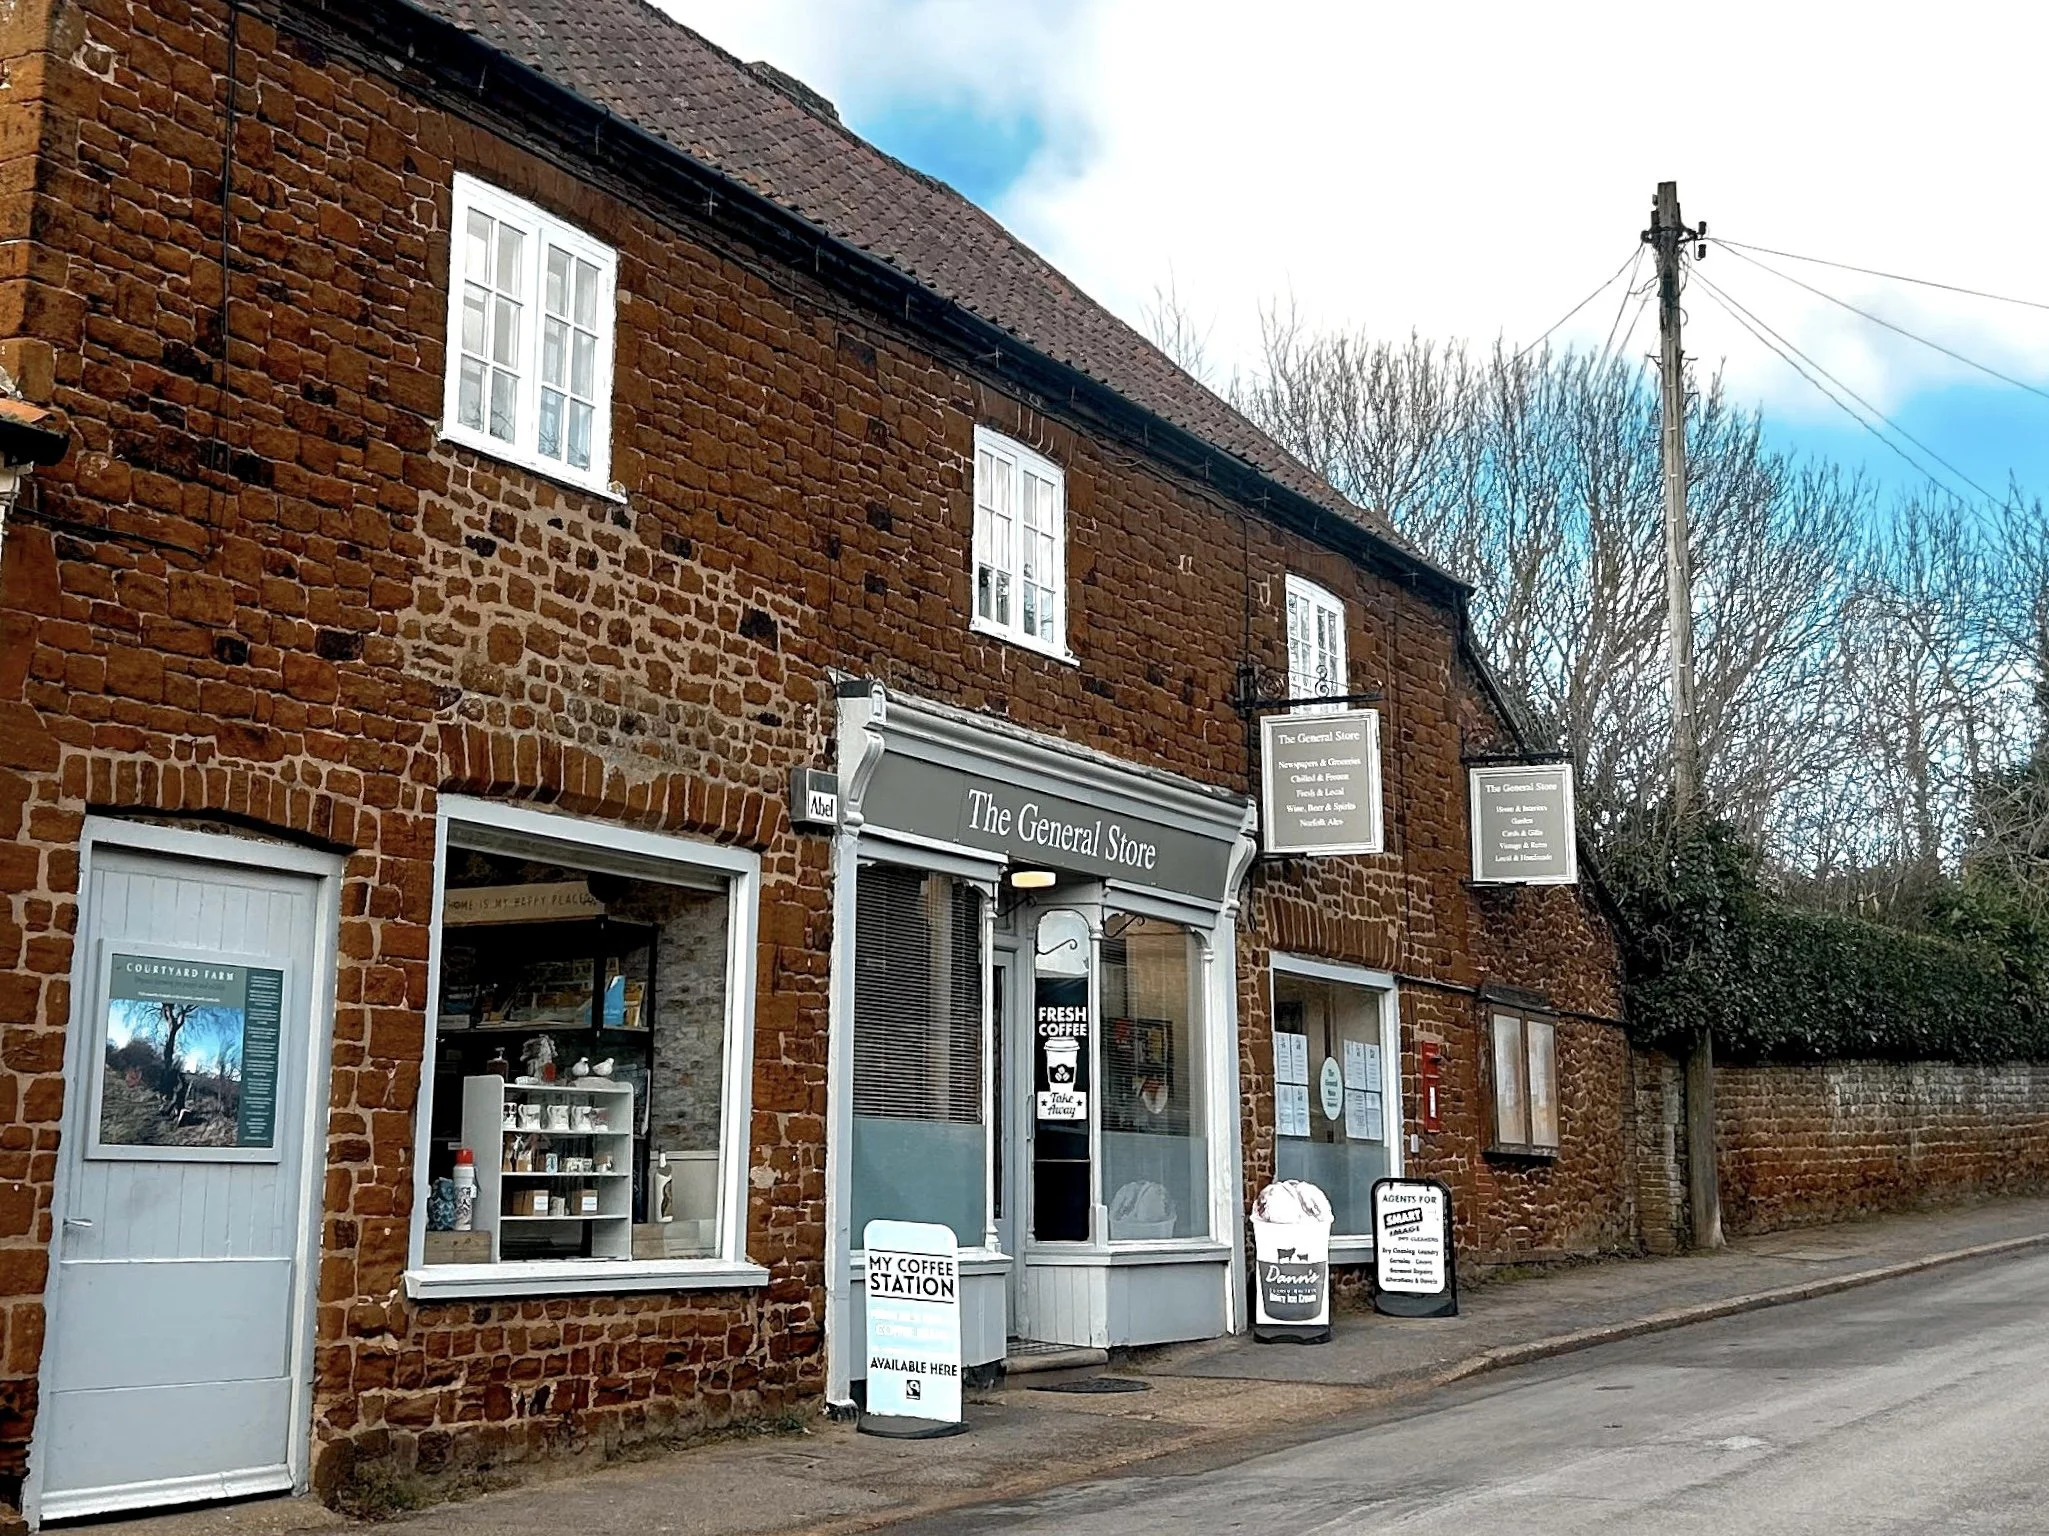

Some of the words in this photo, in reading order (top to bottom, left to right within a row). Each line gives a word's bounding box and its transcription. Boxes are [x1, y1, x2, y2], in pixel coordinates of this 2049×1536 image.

[1278, 734, 1296, 744] The
[1297, 731, 1333, 743] General
[1335, 731, 1360, 742] Store
[1320, 759, 1327, 767] &
[1317, 774, 1324, 782] &
[1317, 789, 1324, 797] &
[1325, 787, 1344, 796] Local
[1485, 784, 1501, 793] The
[1503, 782, 1534, 792] General
[1536, 782, 1557, 791] Store
[811, 795, 834, 817] Abel
[1325, 803, 1332, 811] &
[968, 789, 1012, 836] The
[1017, 803, 1101, 857] General
[1105, 824, 1156, 870] Store
[127, 963, 198, 978] COURTYARD
[204, 970, 234, 980] FARM
[1038, 1007, 1087, 1022] FRESH
[1039, 1023, 1087, 1036] COFFEE
[1050, 1092, 1074, 1103] Take
[1048, 1104, 1076, 1118] Away
[1383, 1194, 1416, 1203] AGENTS
[1419, 1196, 1437, 1204] FOR
[1386, 1210, 1421, 1226] SMART
[870, 1256, 892, 1271] MY
[898, 1258, 953, 1276] COFFEE
[1266, 1265, 1320, 1284] Dann's
[870, 1273, 954, 1298] STATION
[870, 1357, 927, 1374] AVAILABLE
[931, 1362, 958, 1376] HERE
